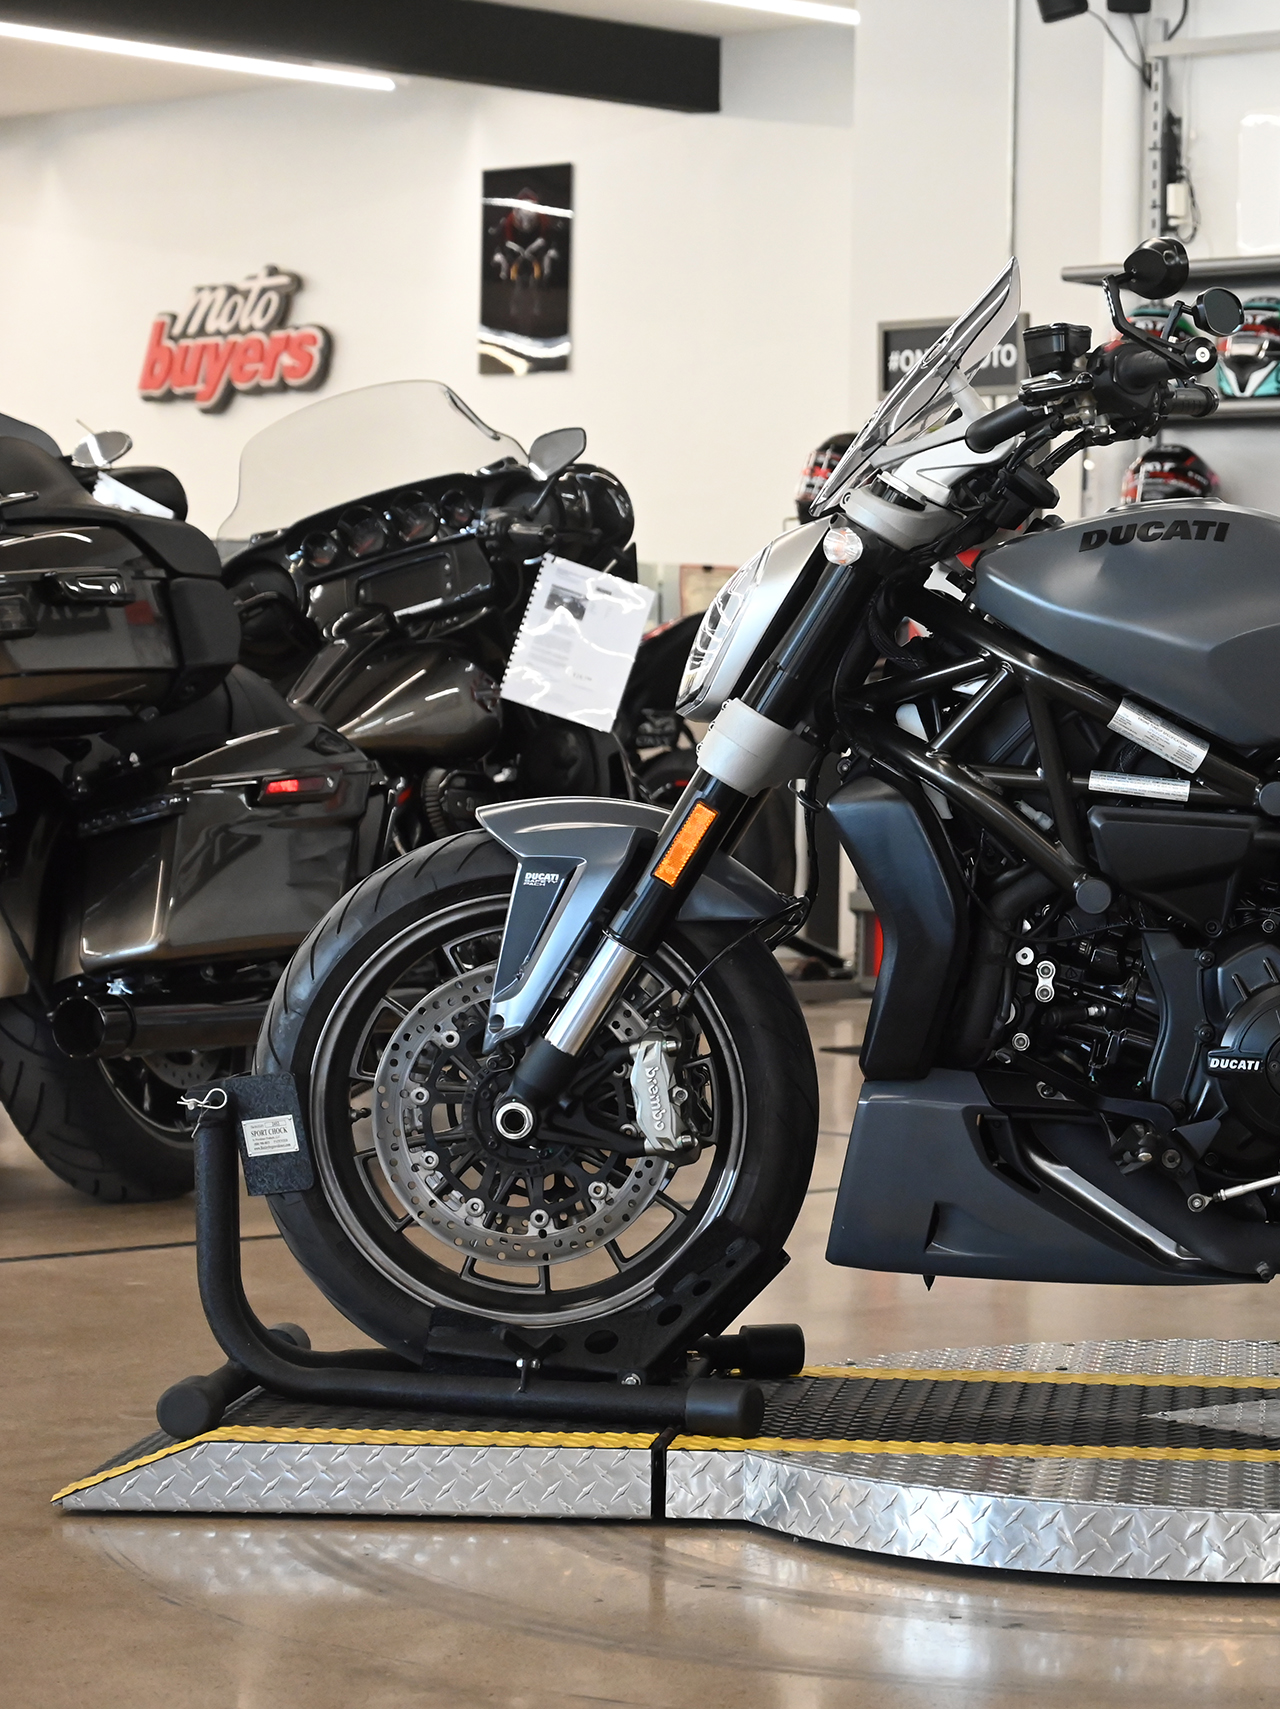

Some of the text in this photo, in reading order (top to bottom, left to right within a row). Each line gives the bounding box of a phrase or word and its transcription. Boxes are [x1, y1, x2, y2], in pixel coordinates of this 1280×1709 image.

[138, 319, 319, 404] buyers
[1079, 519, 1230, 553] DUCATI
[524, 872, 560, 881] DUCATI
[1209, 1058, 1261, 1072] DUCATI
[645, 1066, 667, 1132] brembo
[268, 1127, 288, 1136] CHOCK
